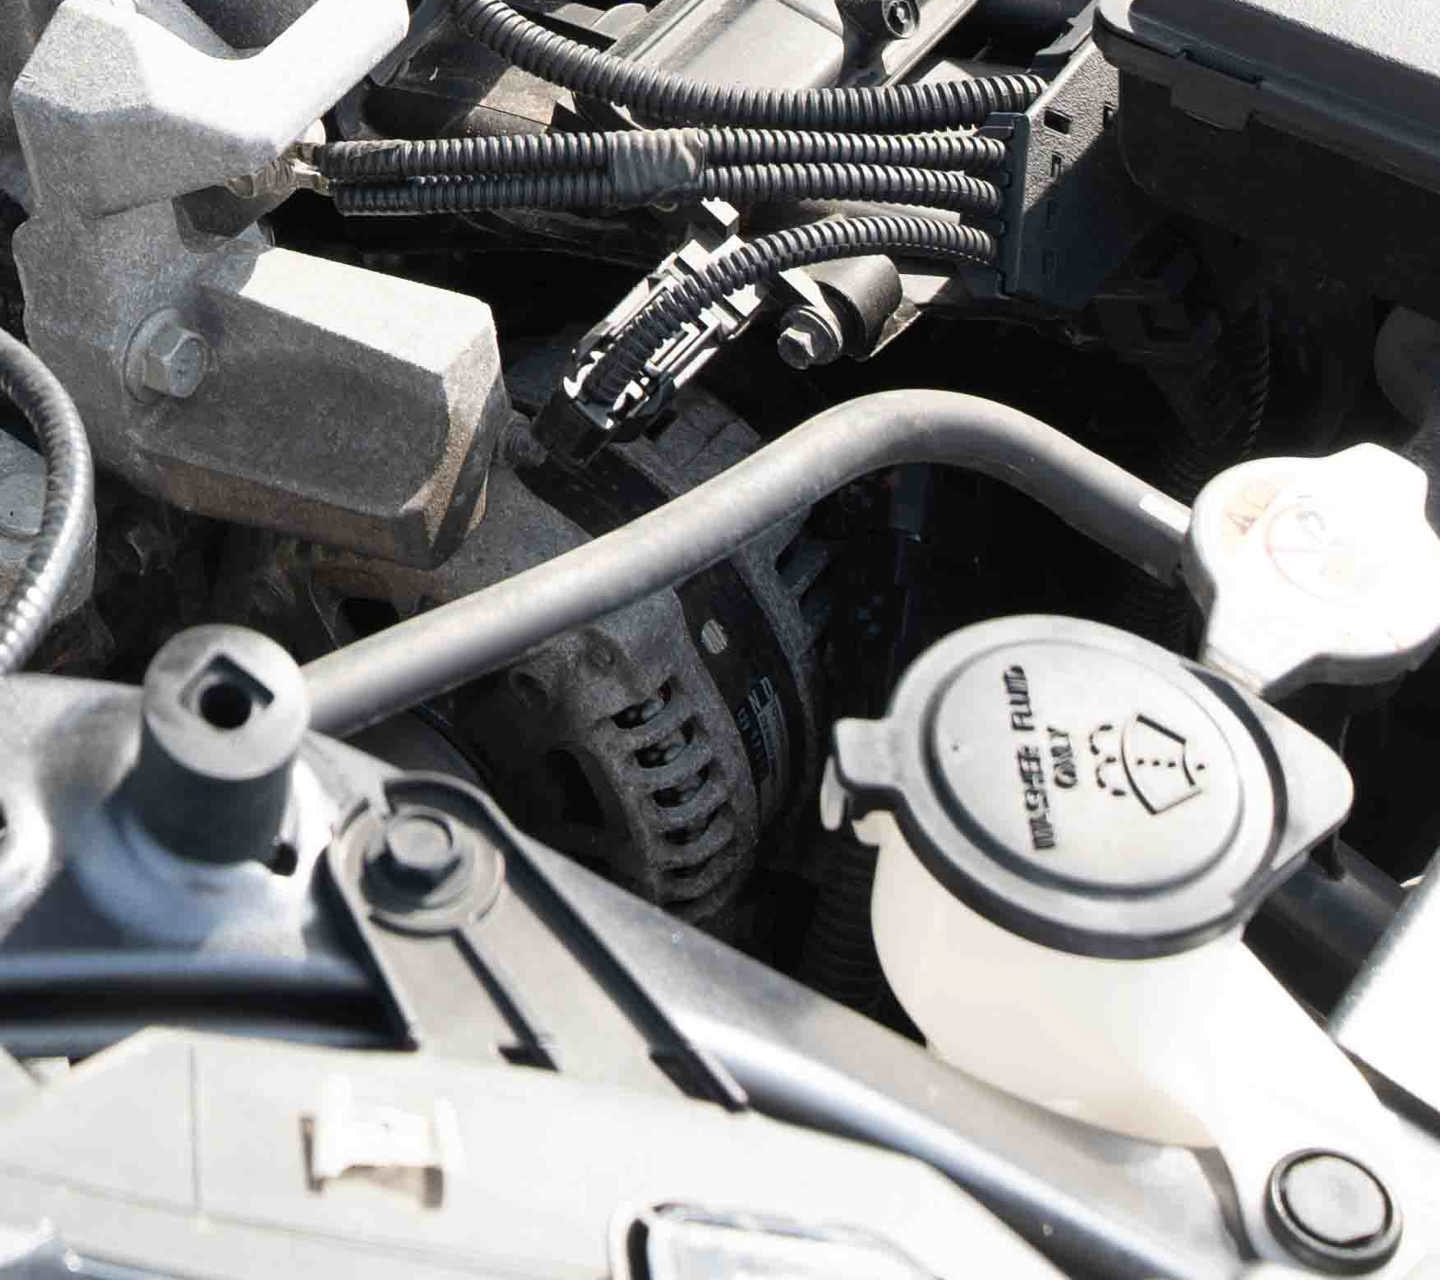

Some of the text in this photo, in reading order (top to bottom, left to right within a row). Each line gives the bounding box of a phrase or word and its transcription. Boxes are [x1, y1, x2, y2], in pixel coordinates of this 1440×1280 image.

[1002, 663, 1056, 851] WASHER FLUID
[1046, 725, 1078, 790] ONLY
